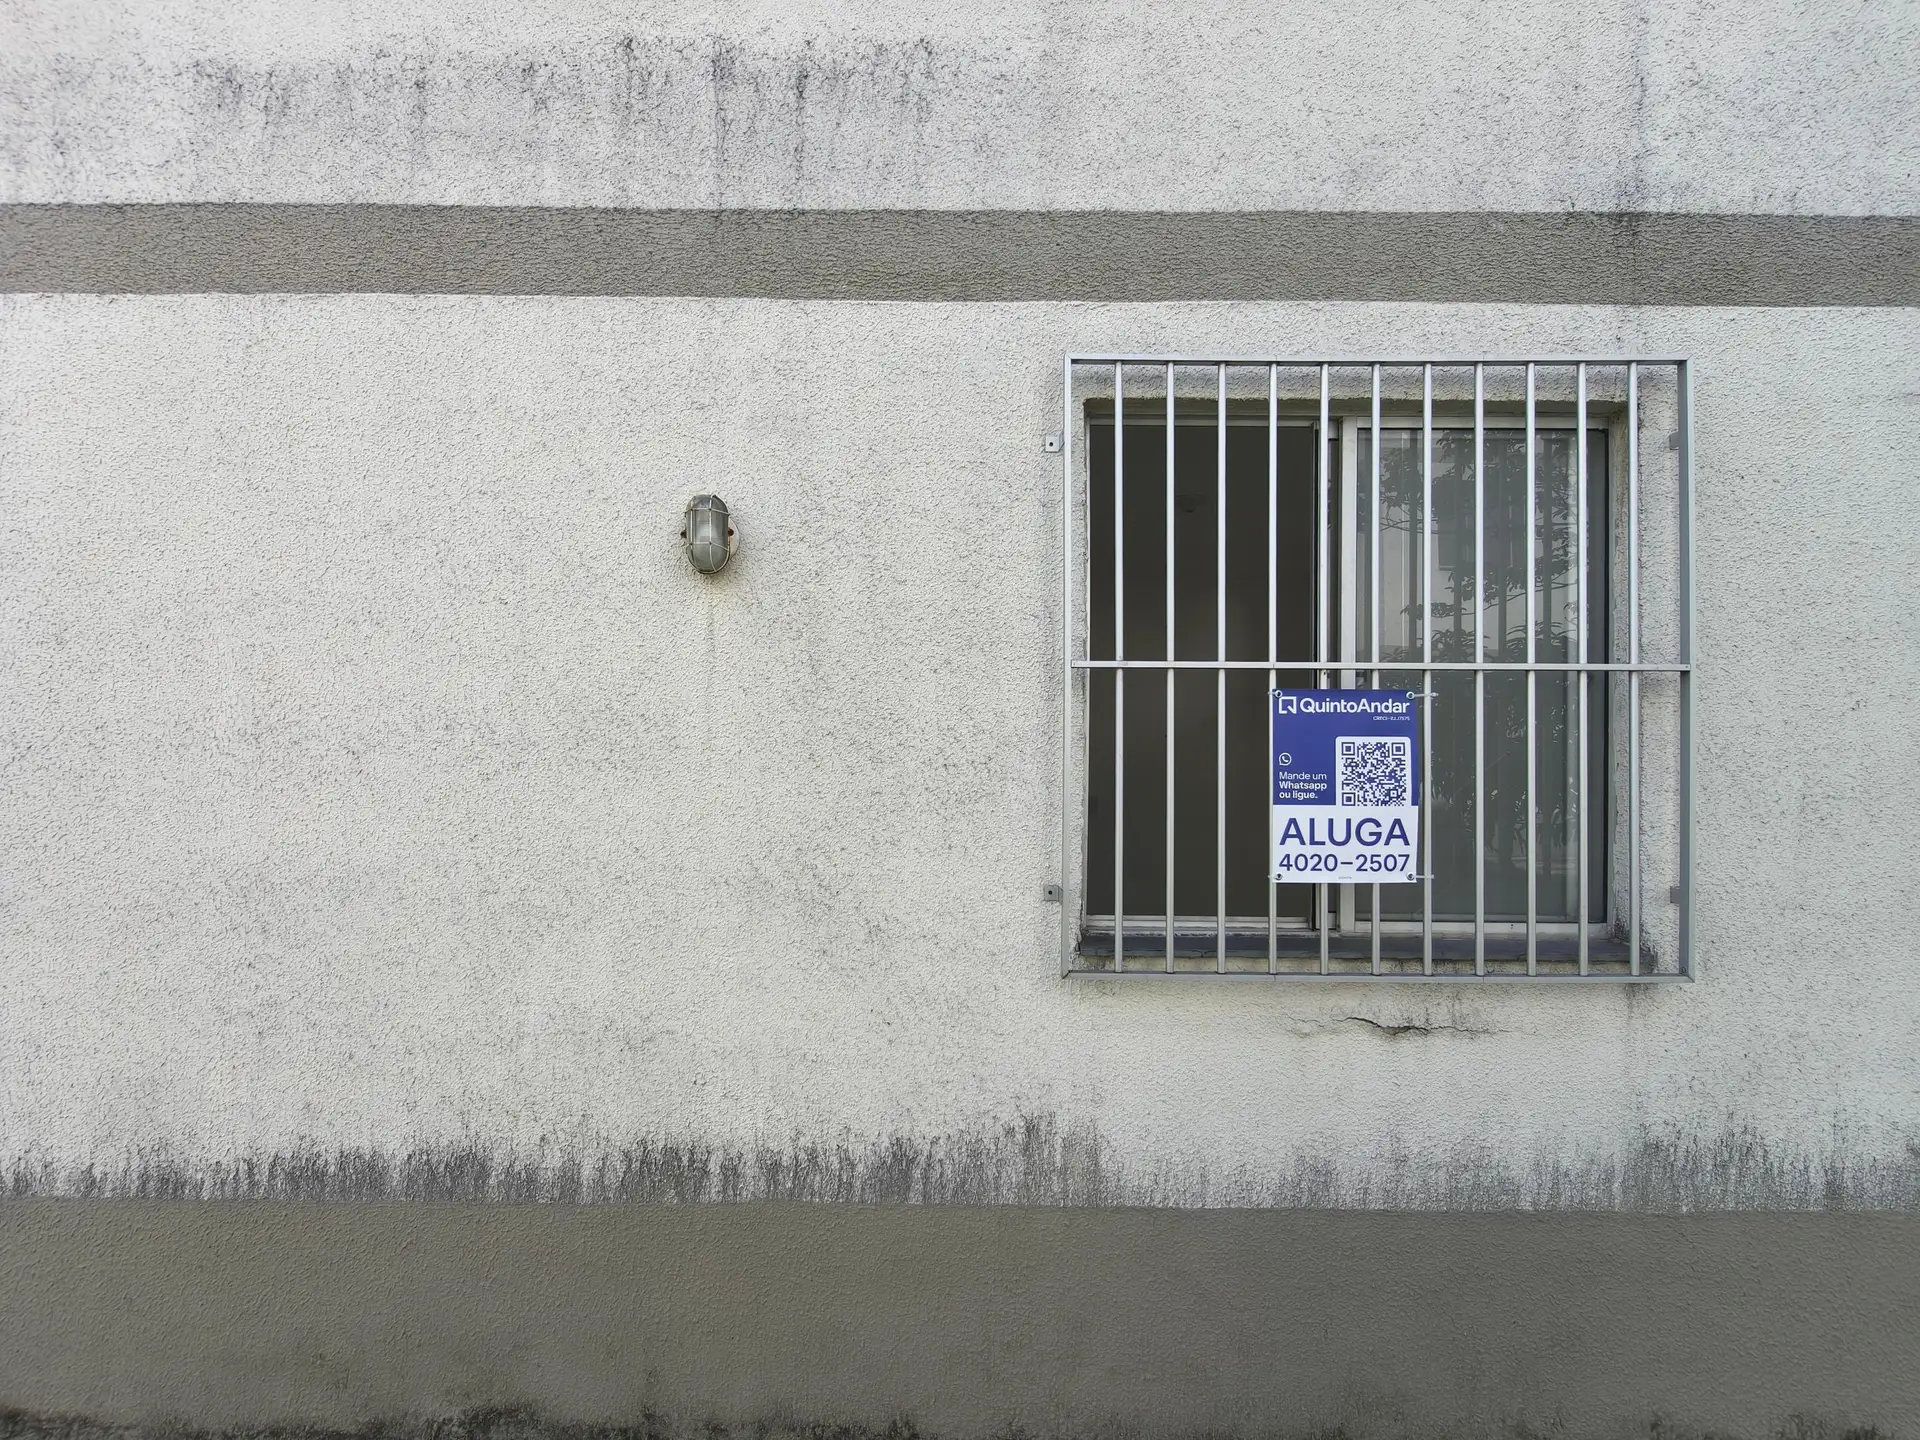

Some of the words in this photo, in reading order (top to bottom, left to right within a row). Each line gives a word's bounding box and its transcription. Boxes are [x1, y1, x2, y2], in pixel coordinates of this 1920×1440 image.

[1300, 698, 1410, 713] QuintoAndar
[1279, 771, 1311, 780] Mande
[1279, 781, 1327, 791] Whatsapp
[1279, 791, 1291, 799] ou
[1292, 790, 1319, 800] ligue.
[1279, 817, 1410, 847] ALUGA
[1279, 853, 1410, 872] 4020-2507
